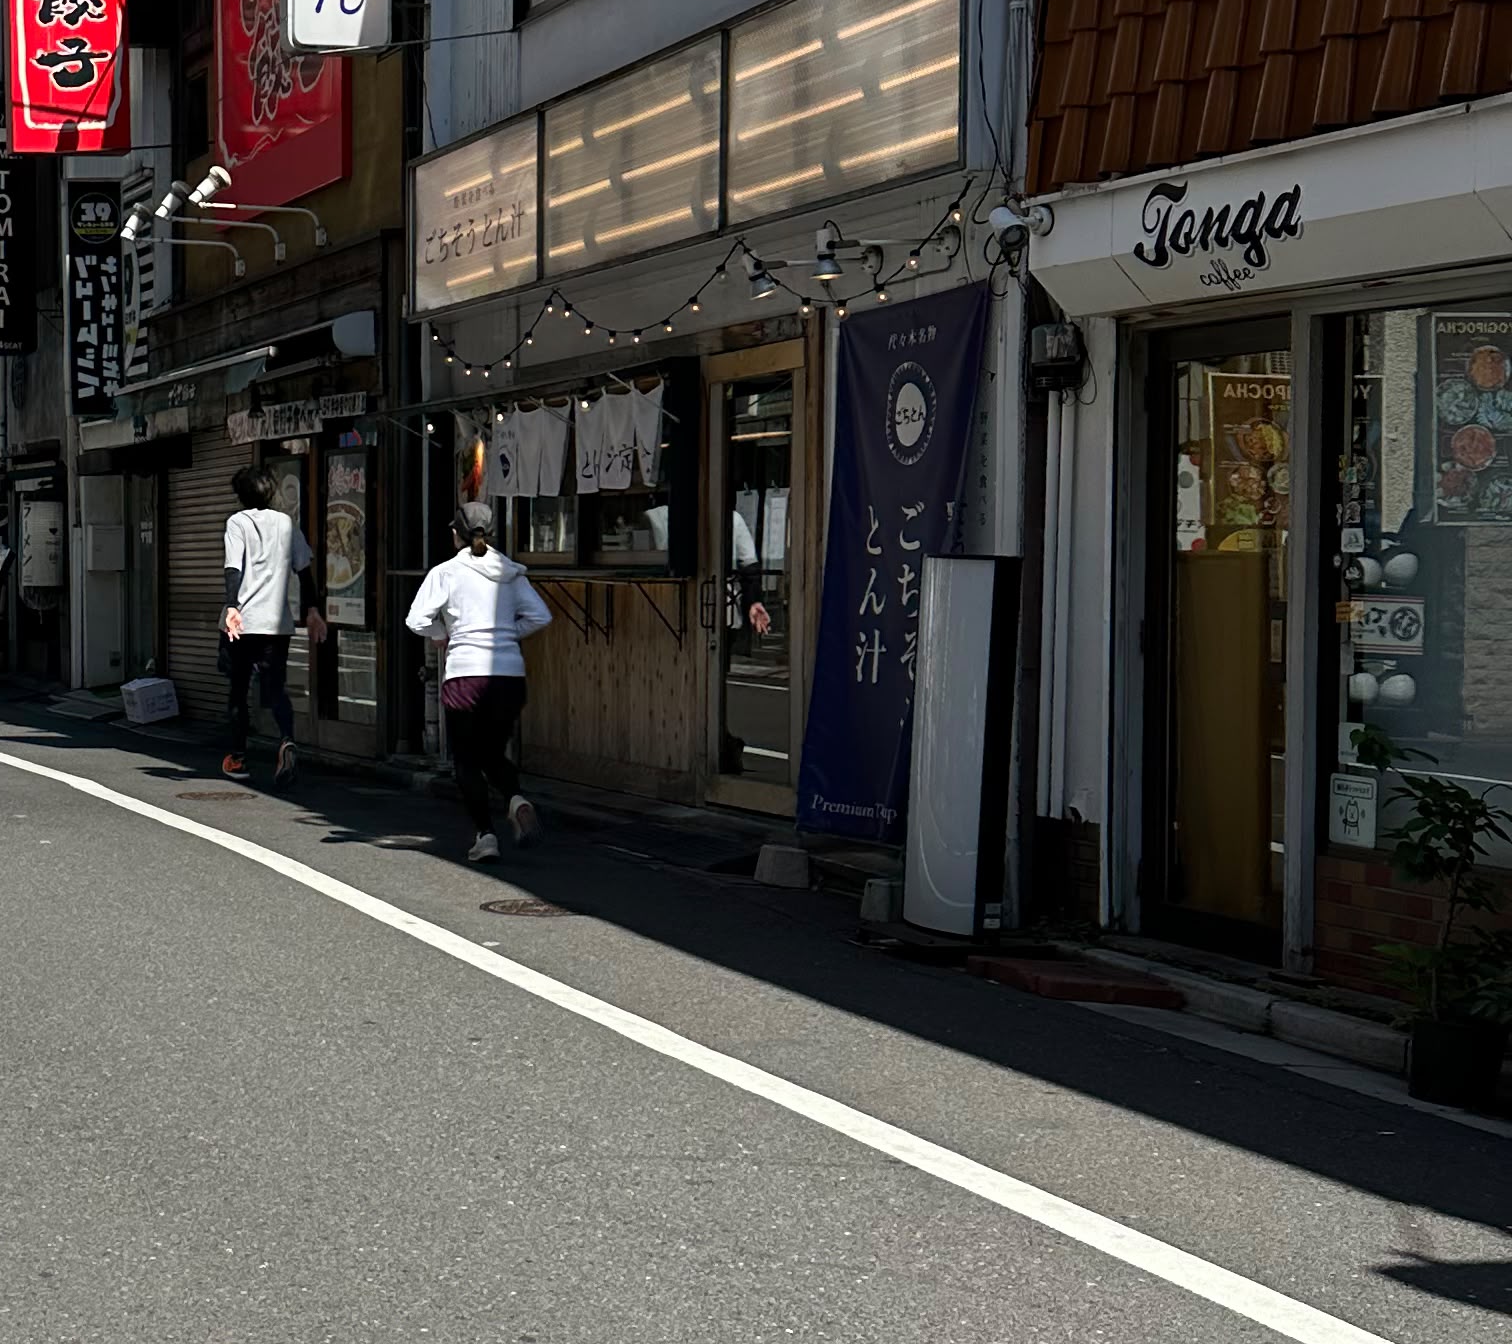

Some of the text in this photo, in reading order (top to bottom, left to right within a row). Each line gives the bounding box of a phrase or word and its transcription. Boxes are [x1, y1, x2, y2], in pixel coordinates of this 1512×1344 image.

[81, 202, 110, 221] 39
[1133, 181, 1303, 267] Tonga
[1200, 259, 1256, 291] coffee
[75, 255, 99, 399] シューマッハ
[855, 504, 885, 684] とん汁
